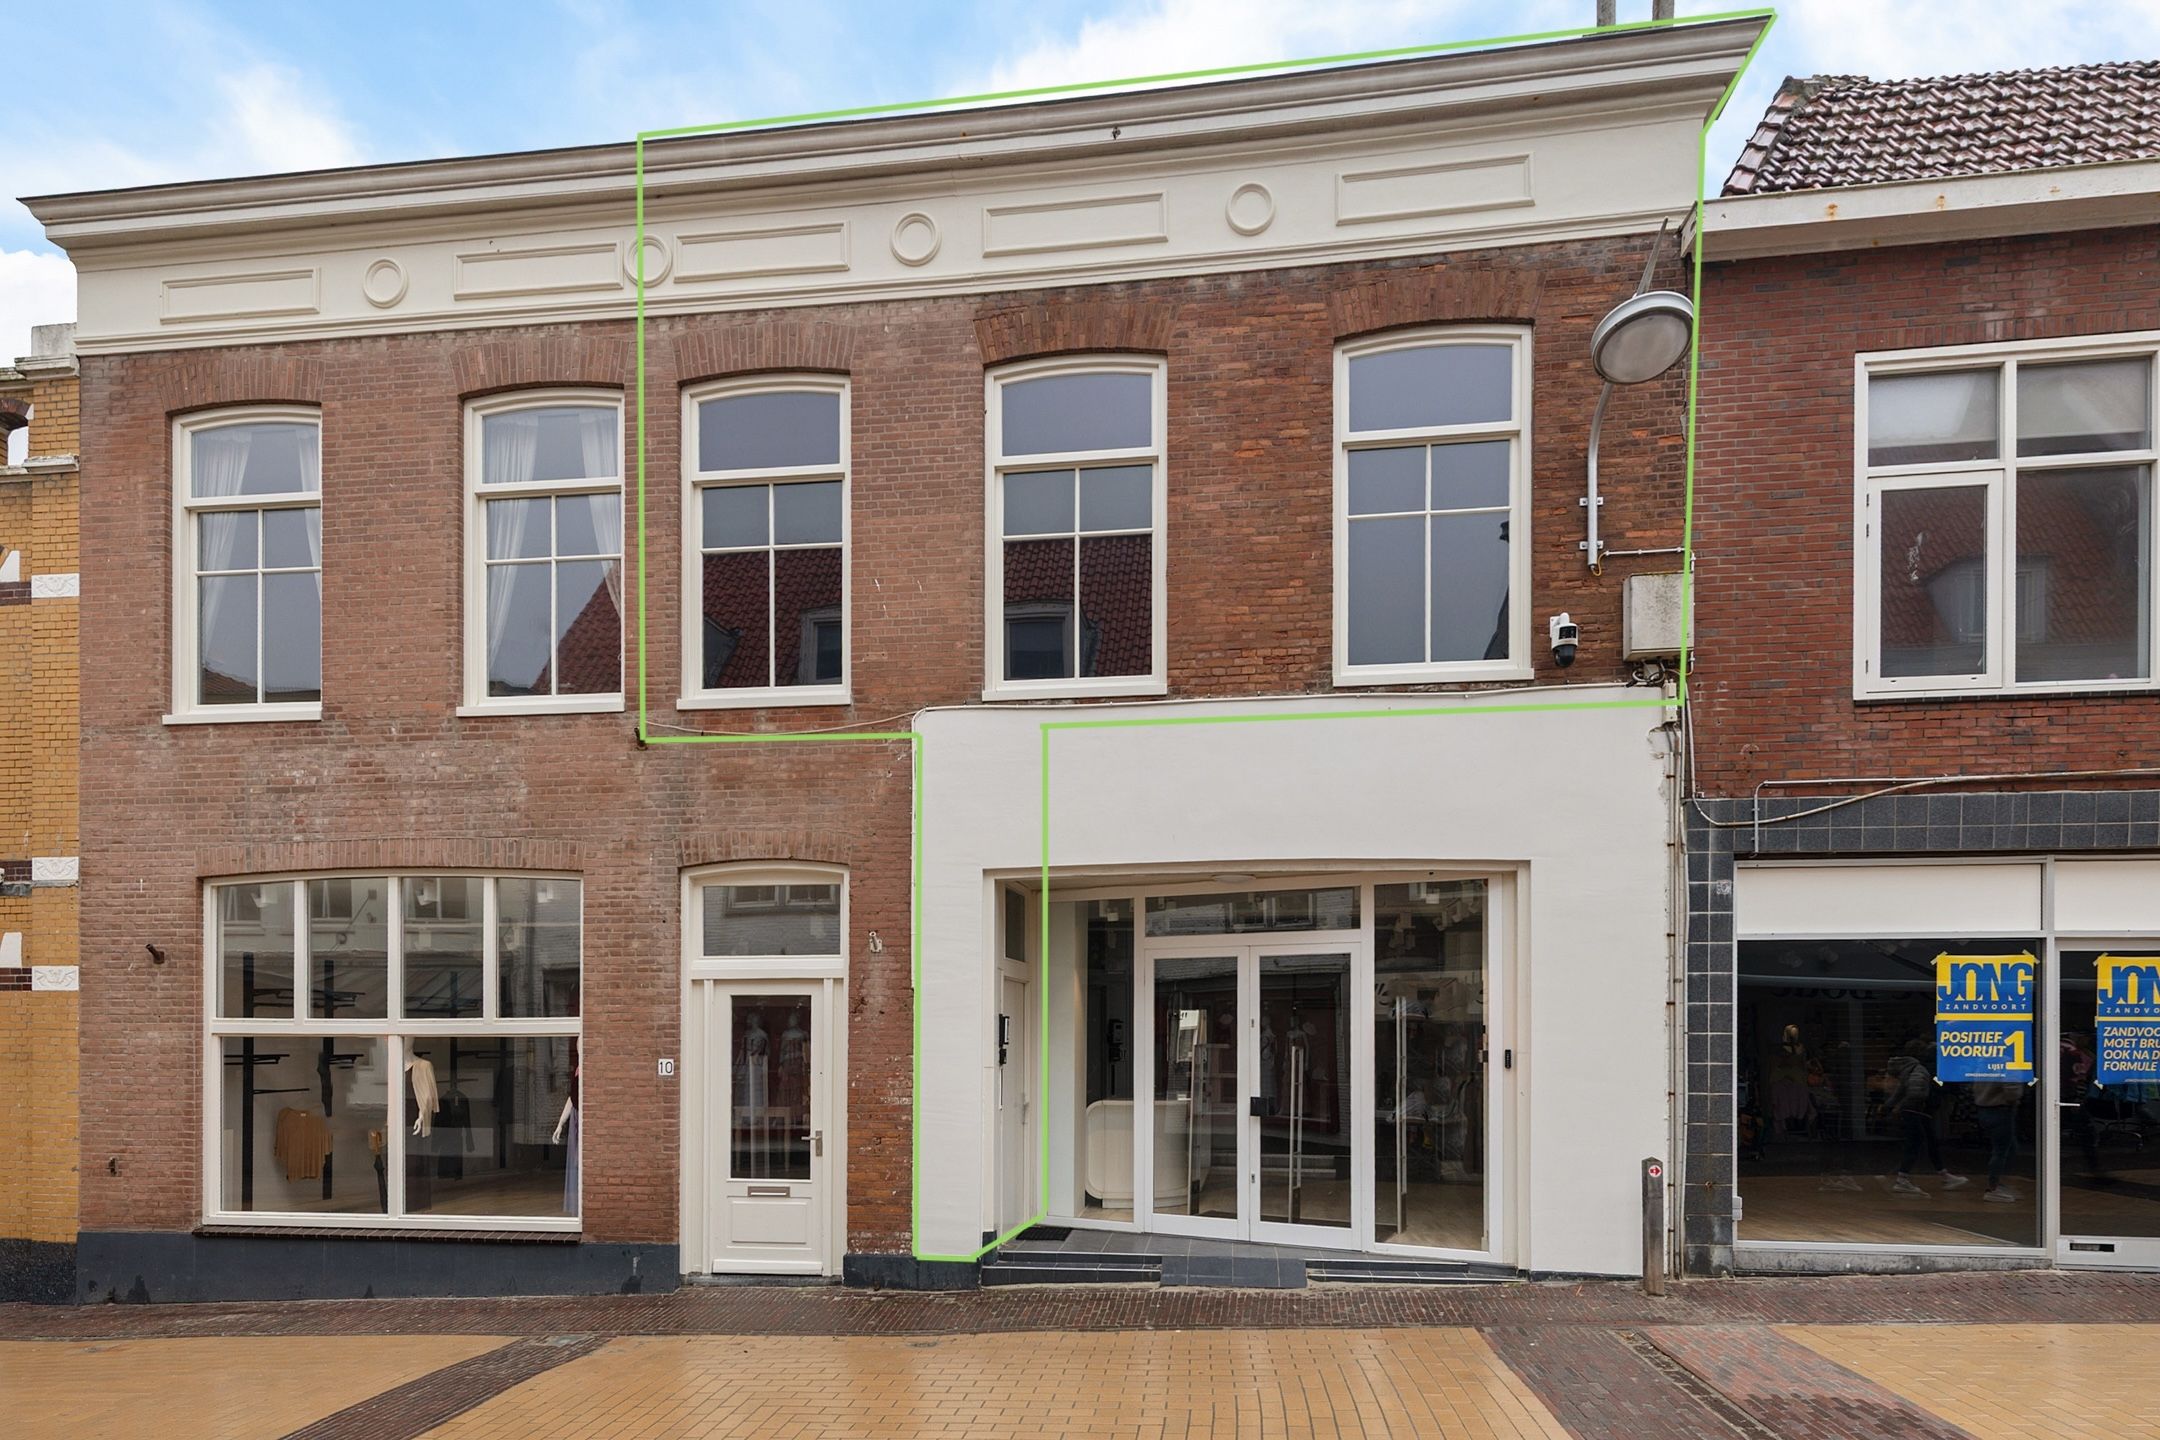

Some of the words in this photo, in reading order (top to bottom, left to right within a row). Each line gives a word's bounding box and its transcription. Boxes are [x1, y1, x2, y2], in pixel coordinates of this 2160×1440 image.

[1937, 962, 2033, 1002] JONG
[1940, 1031, 2003, 1044] POSITIEF
[2103, 1038, 2138, 1048] MOET
[1941, 1045, 2007, 1057] VOORUIT
[2004, 1030, 2033, 1071] 1
[2103, 1050, 2131, 1060] OOK
[2132, 1050, 2149, 1060] NA
[659, 1061, 673, 1074] 10
[2103, 1061, 2158, 1072] FORMULE
